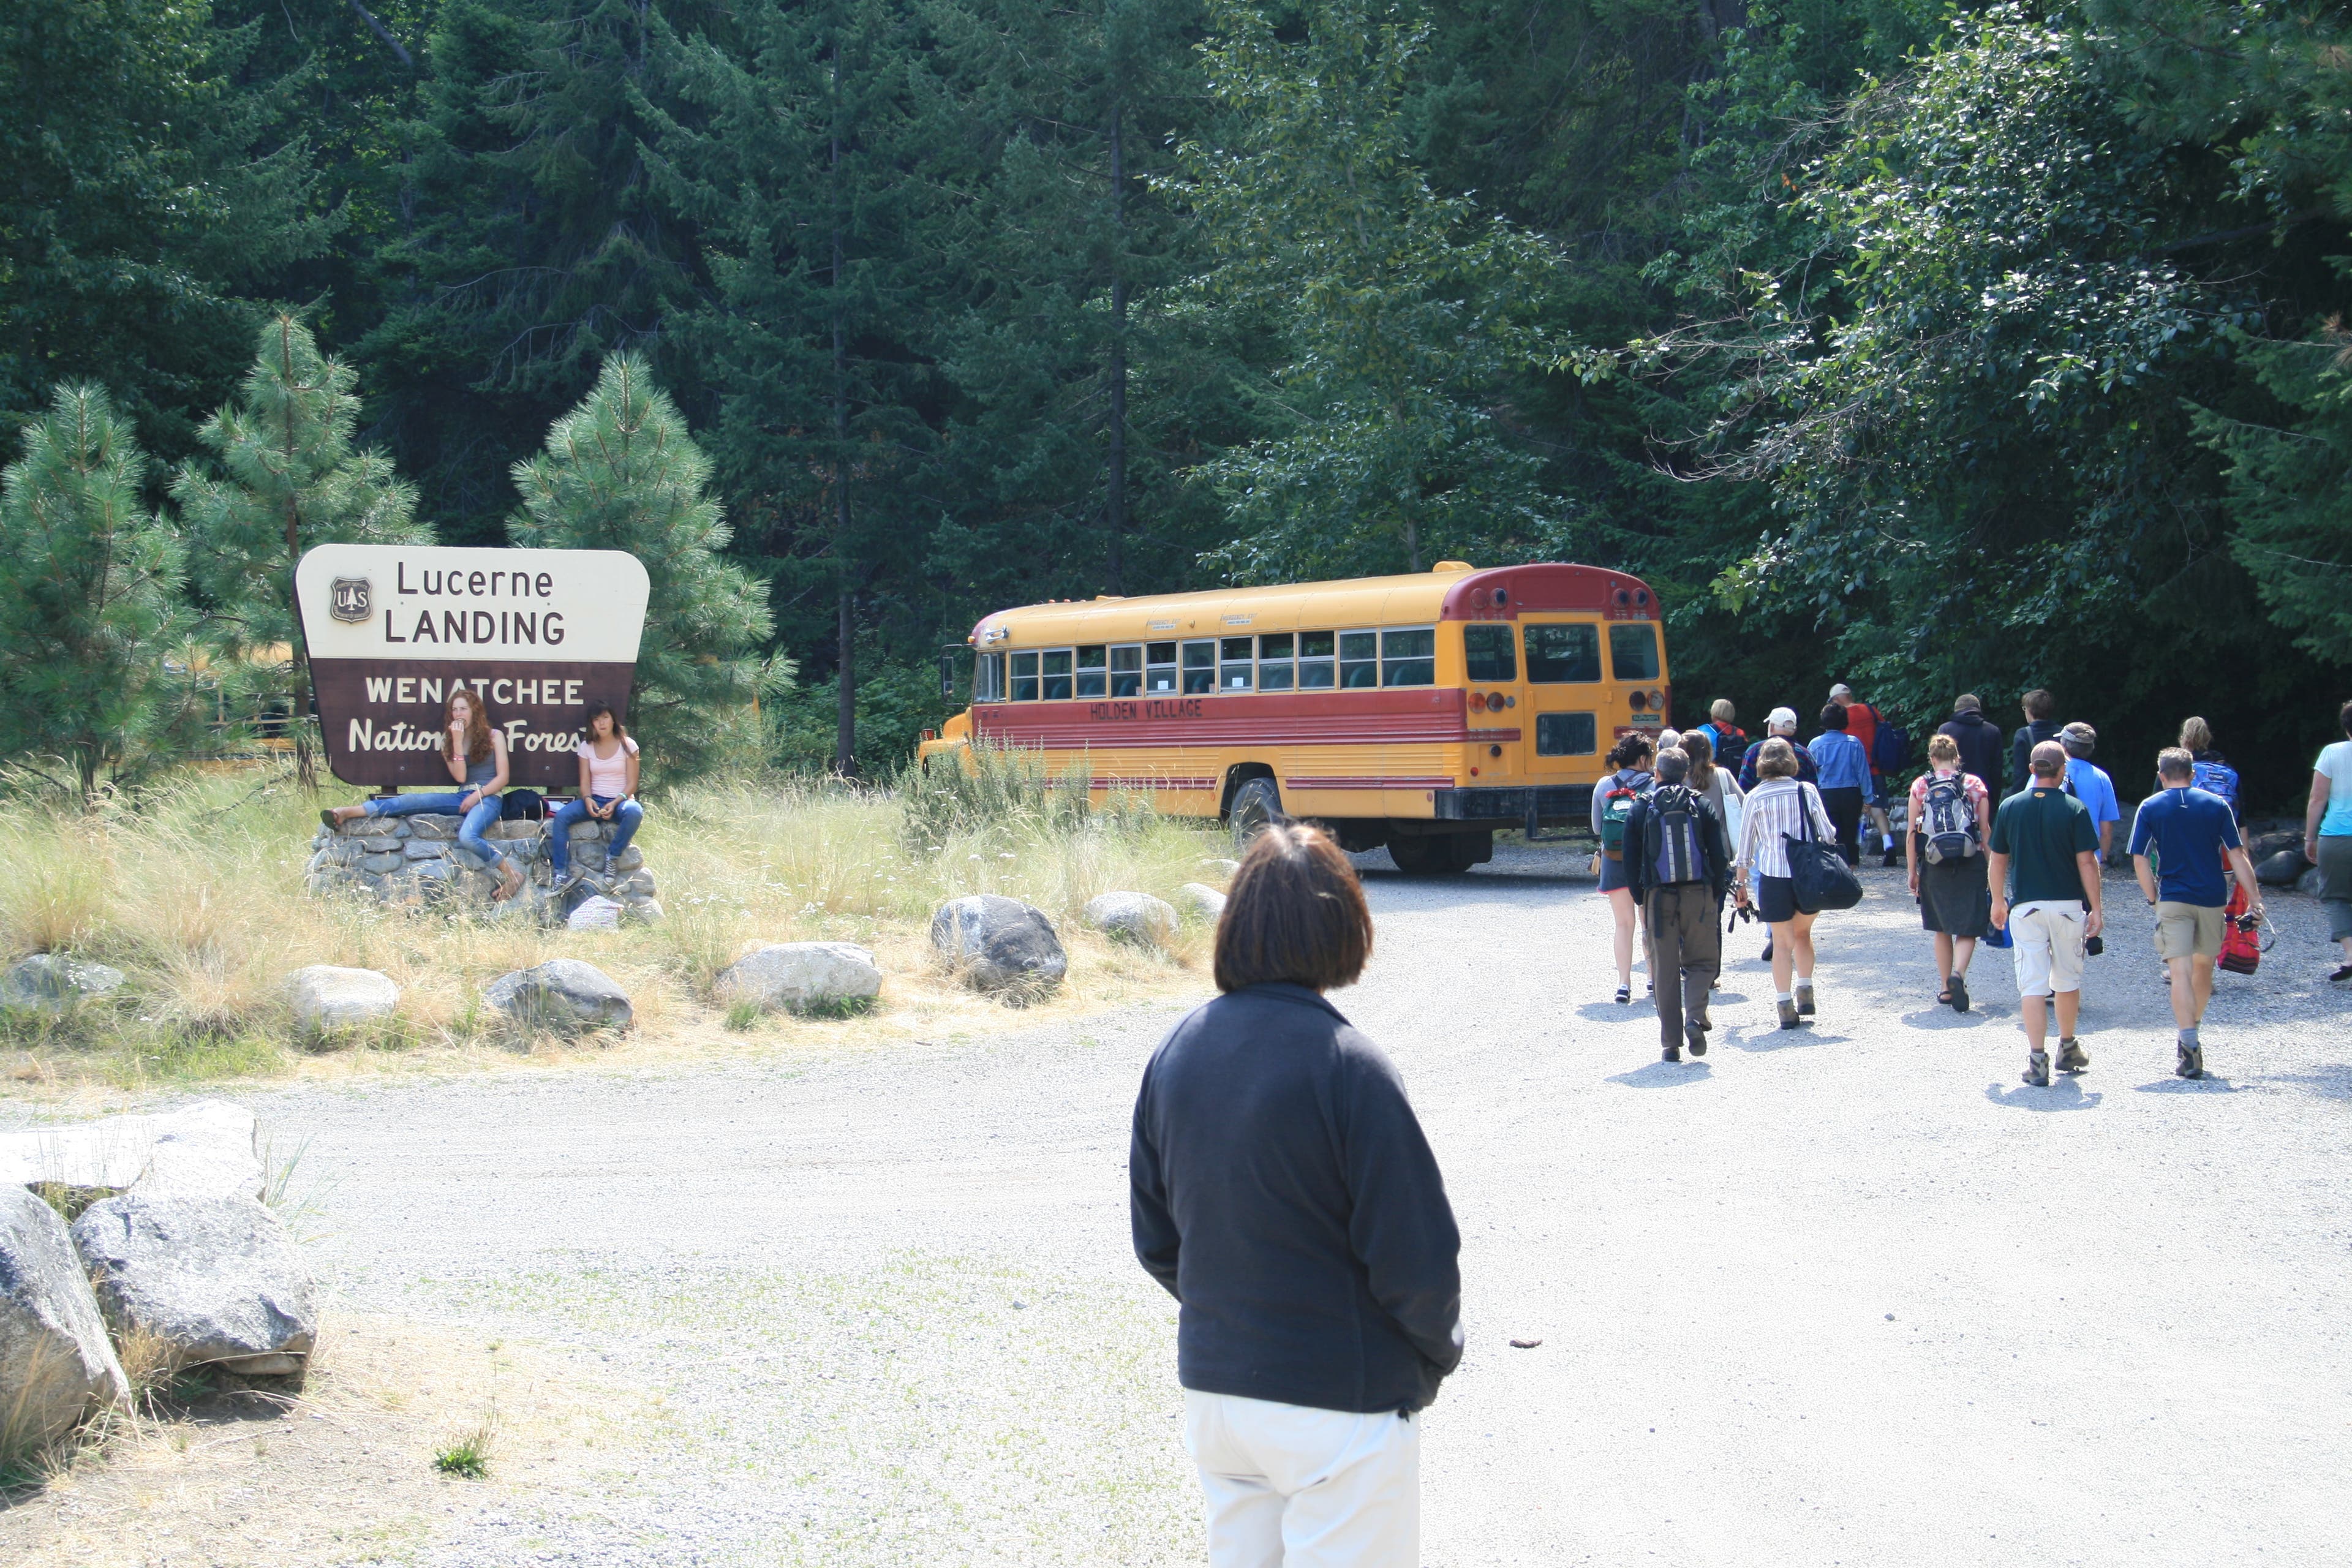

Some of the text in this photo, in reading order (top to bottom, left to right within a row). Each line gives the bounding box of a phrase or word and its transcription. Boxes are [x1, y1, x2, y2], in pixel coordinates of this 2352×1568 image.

[398, 562, 553, 598] Lucerne
[386, 609, 565, 646] LANDING
[366, 677, 584, 704] WENATCHEE
[1090, 699, 1202, 720] HOLDEN VILLAGE
[349, 718, 587, 753] Nation Fores
